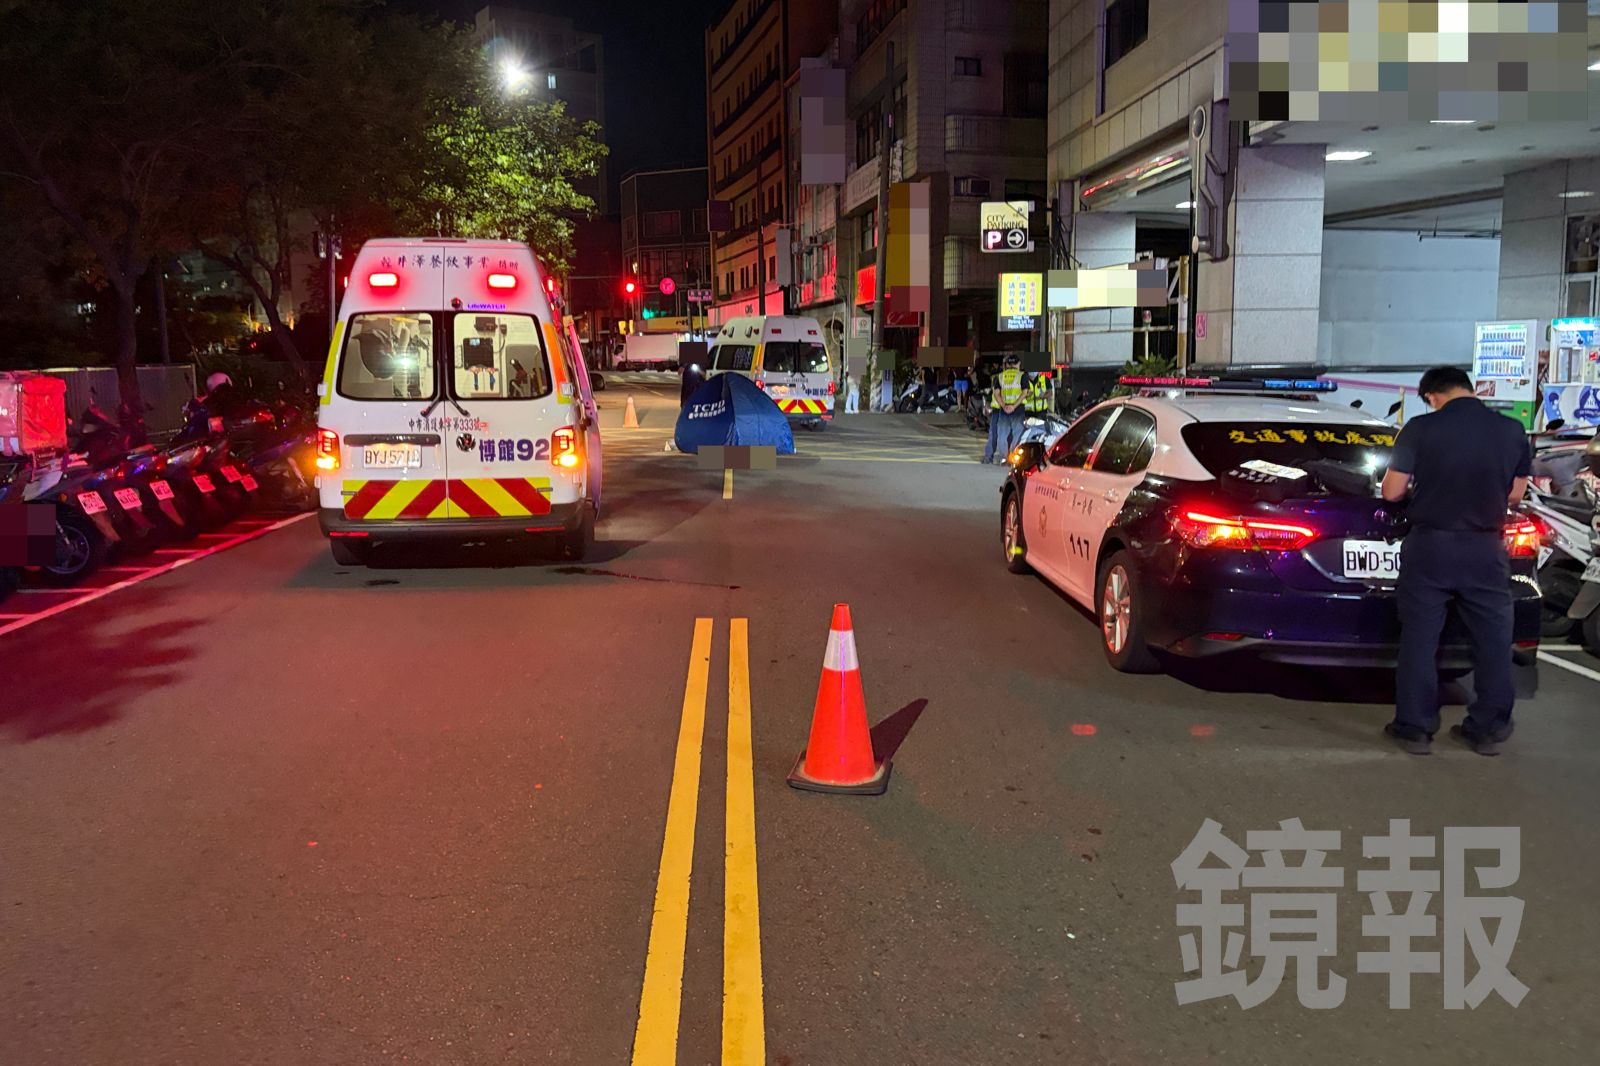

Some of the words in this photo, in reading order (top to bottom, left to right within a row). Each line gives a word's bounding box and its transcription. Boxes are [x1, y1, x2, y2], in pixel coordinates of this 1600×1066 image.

[986, 214, 1006, 223] CITY
[986, 221, 1025, 230] PARKING
[692, 400, 726, 413] TCPD
[1069, 533, 1090, 561] 117
